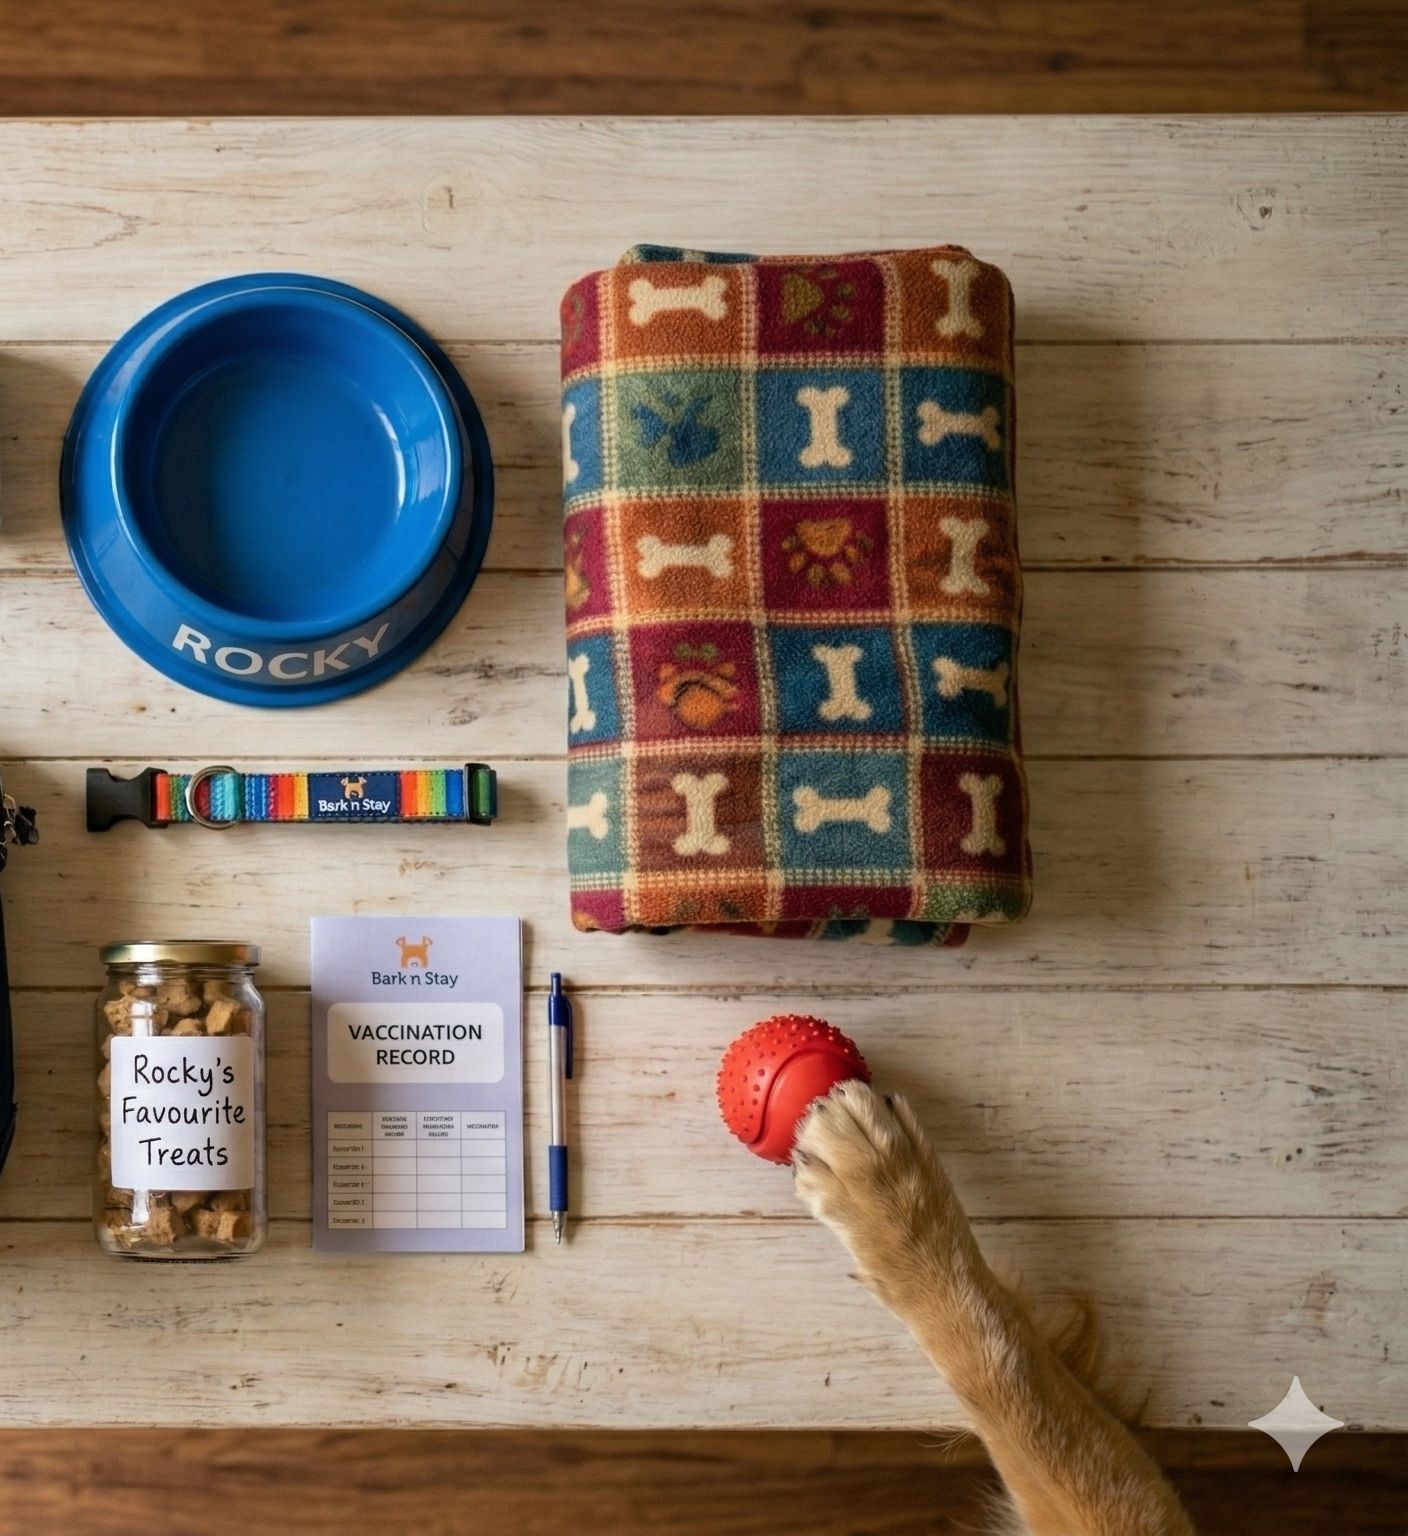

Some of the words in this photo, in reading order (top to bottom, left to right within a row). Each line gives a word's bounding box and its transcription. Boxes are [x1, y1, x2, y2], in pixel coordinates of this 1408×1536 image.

[172, 622, 389, 679] ROCKY
[351, 801, 360, 811] n
[362, 798, 391, 814] Stay
[371, 971, 407, 985] Bark
[411, 974, 421, 985] n
[425, 971, 458, 988] Stay
[348, 1024, 482, 1040] VACCINATION
[376, 1050, 455, 1065] RECORD
[134, 1054, 235, 1097] Rocky's
[122, 1096, 246, 1124] Favourite
[139, 1137, 228, 1166] Treats
